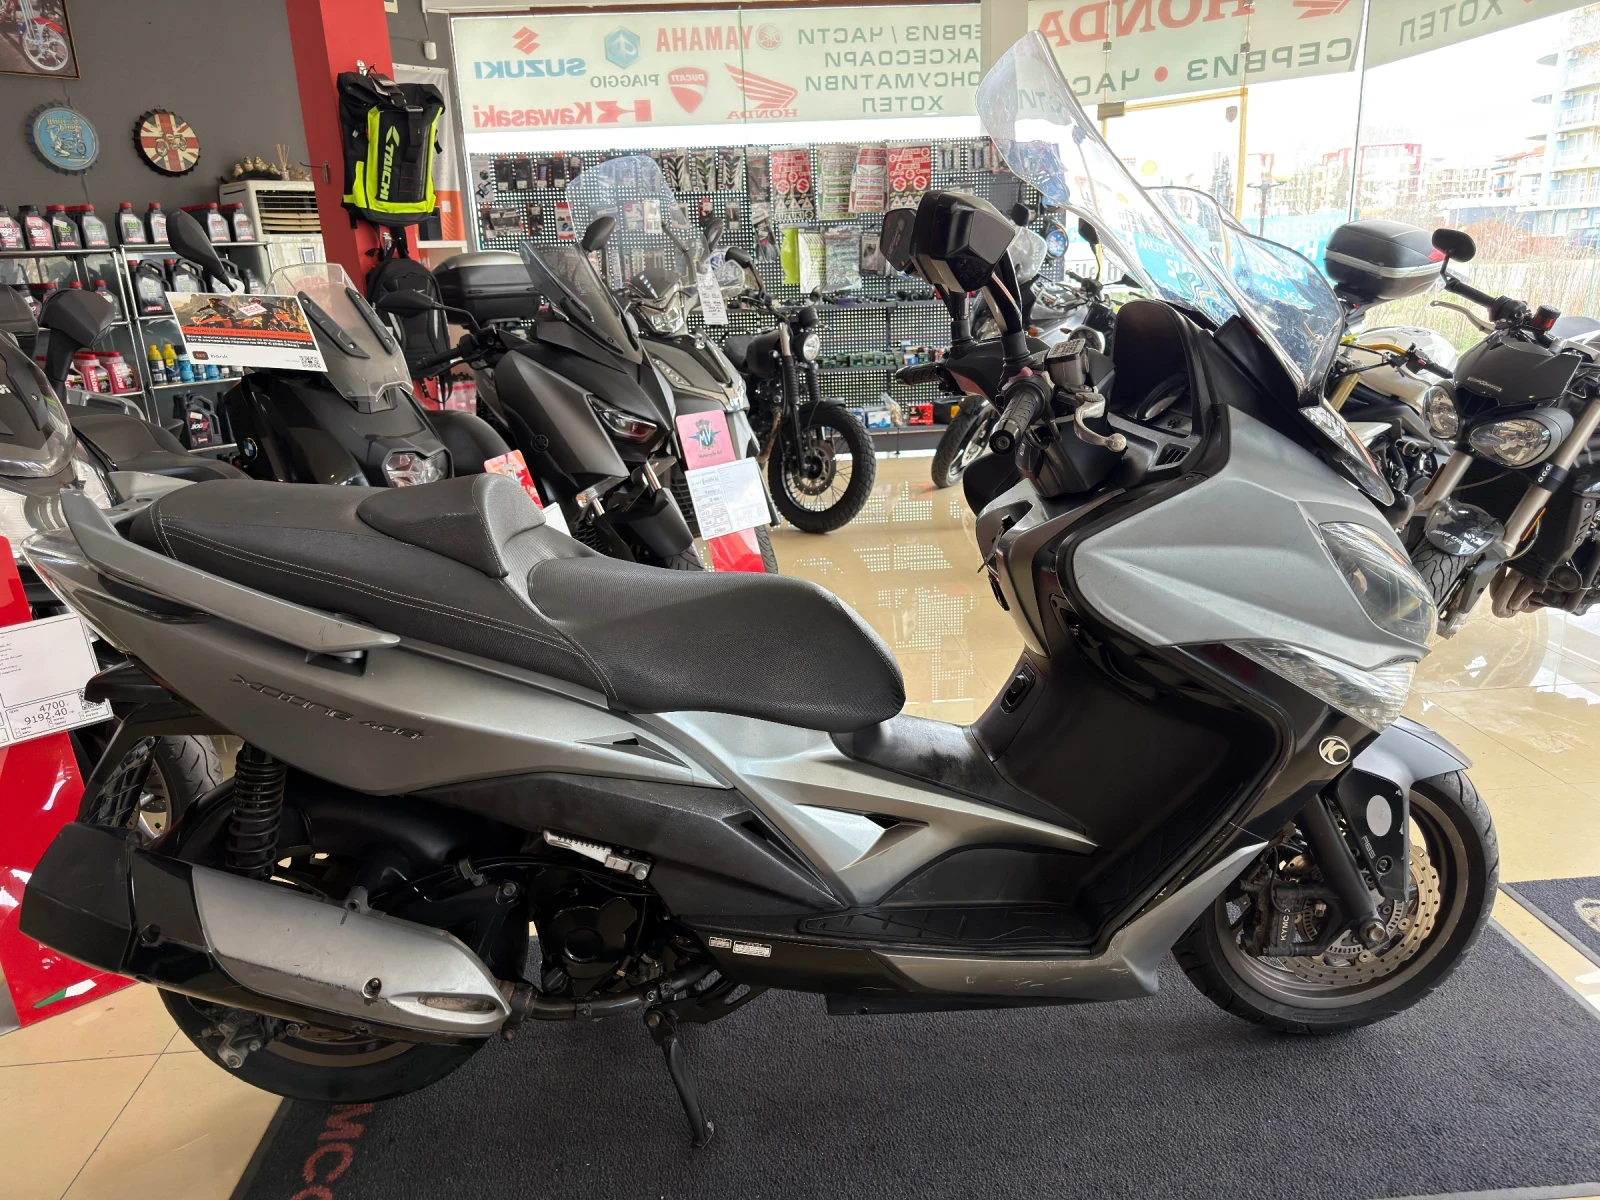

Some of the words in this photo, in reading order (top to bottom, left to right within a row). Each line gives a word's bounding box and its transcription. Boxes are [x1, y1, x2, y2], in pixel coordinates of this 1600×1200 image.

[379, 143, 394, 201] TAICHI
[89, 369, 100, 392] MOTUL
[24, 707, 68, 726] 9192.40
[39, 699, 66, 713] 4700
[1361, 835, 1377, 860] ABS
